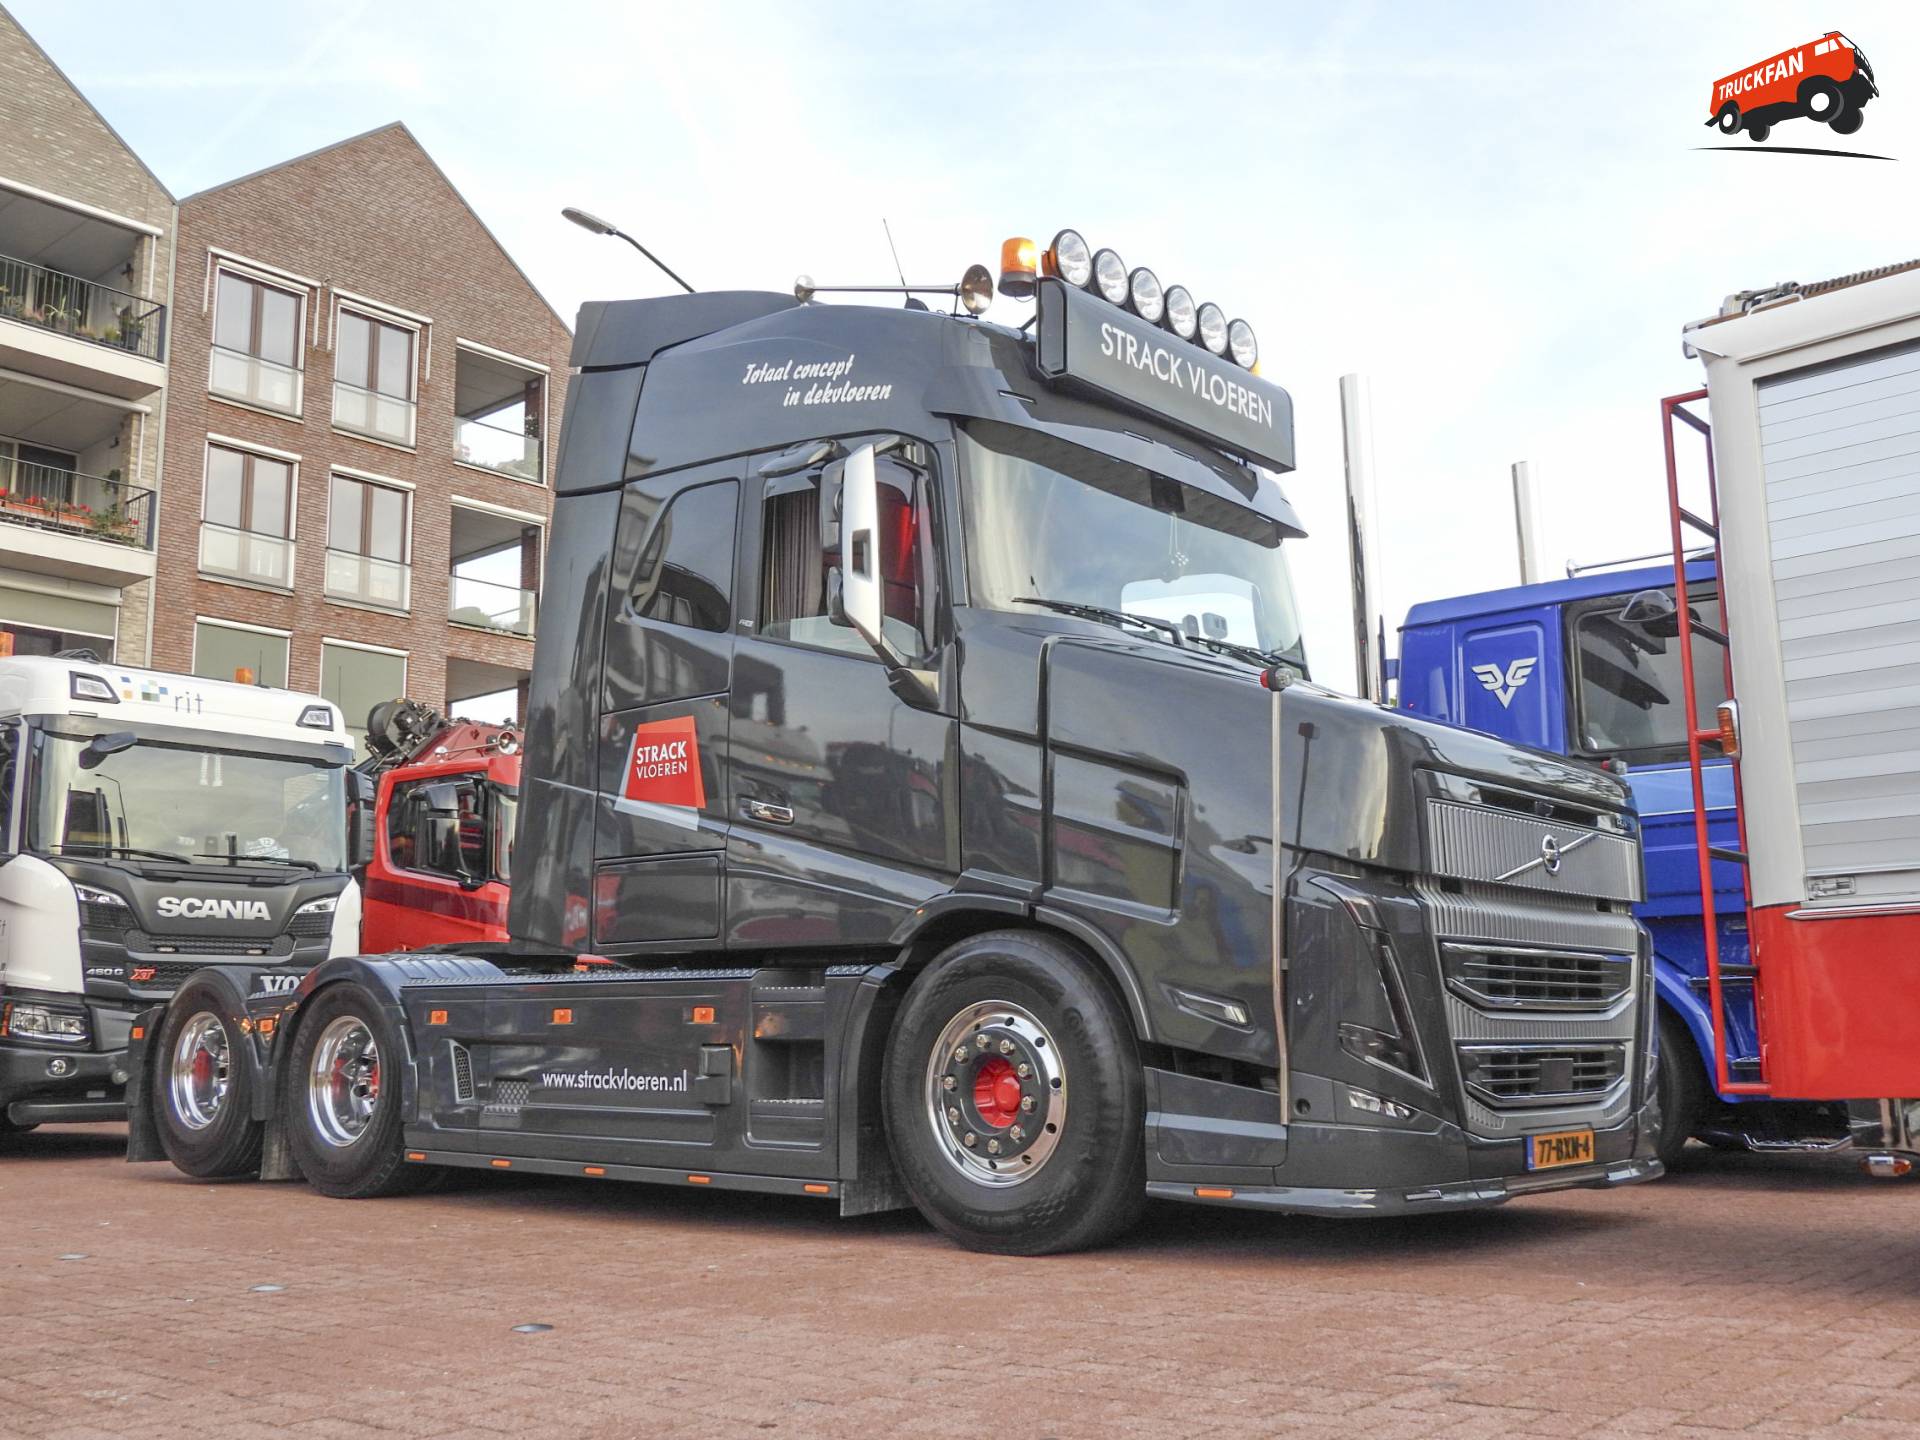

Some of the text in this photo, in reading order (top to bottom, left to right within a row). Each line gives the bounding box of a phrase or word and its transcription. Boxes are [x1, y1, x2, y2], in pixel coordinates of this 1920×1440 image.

[742, 354, 855, 385] Totaal concept
[1101, 322, 1272, 430] STRACK VLOEREN
[783, 380, 892, 407] in dekvloeren
[174, 691, 204, 715] rit
[636, 740, 688, 780] STRACK VLOEREN
[156, 896, 271, 921] SCANIA
[260, 975, 306, 993] VO
[542, 1067, 687, 1092] www.strackvloeren.nl
